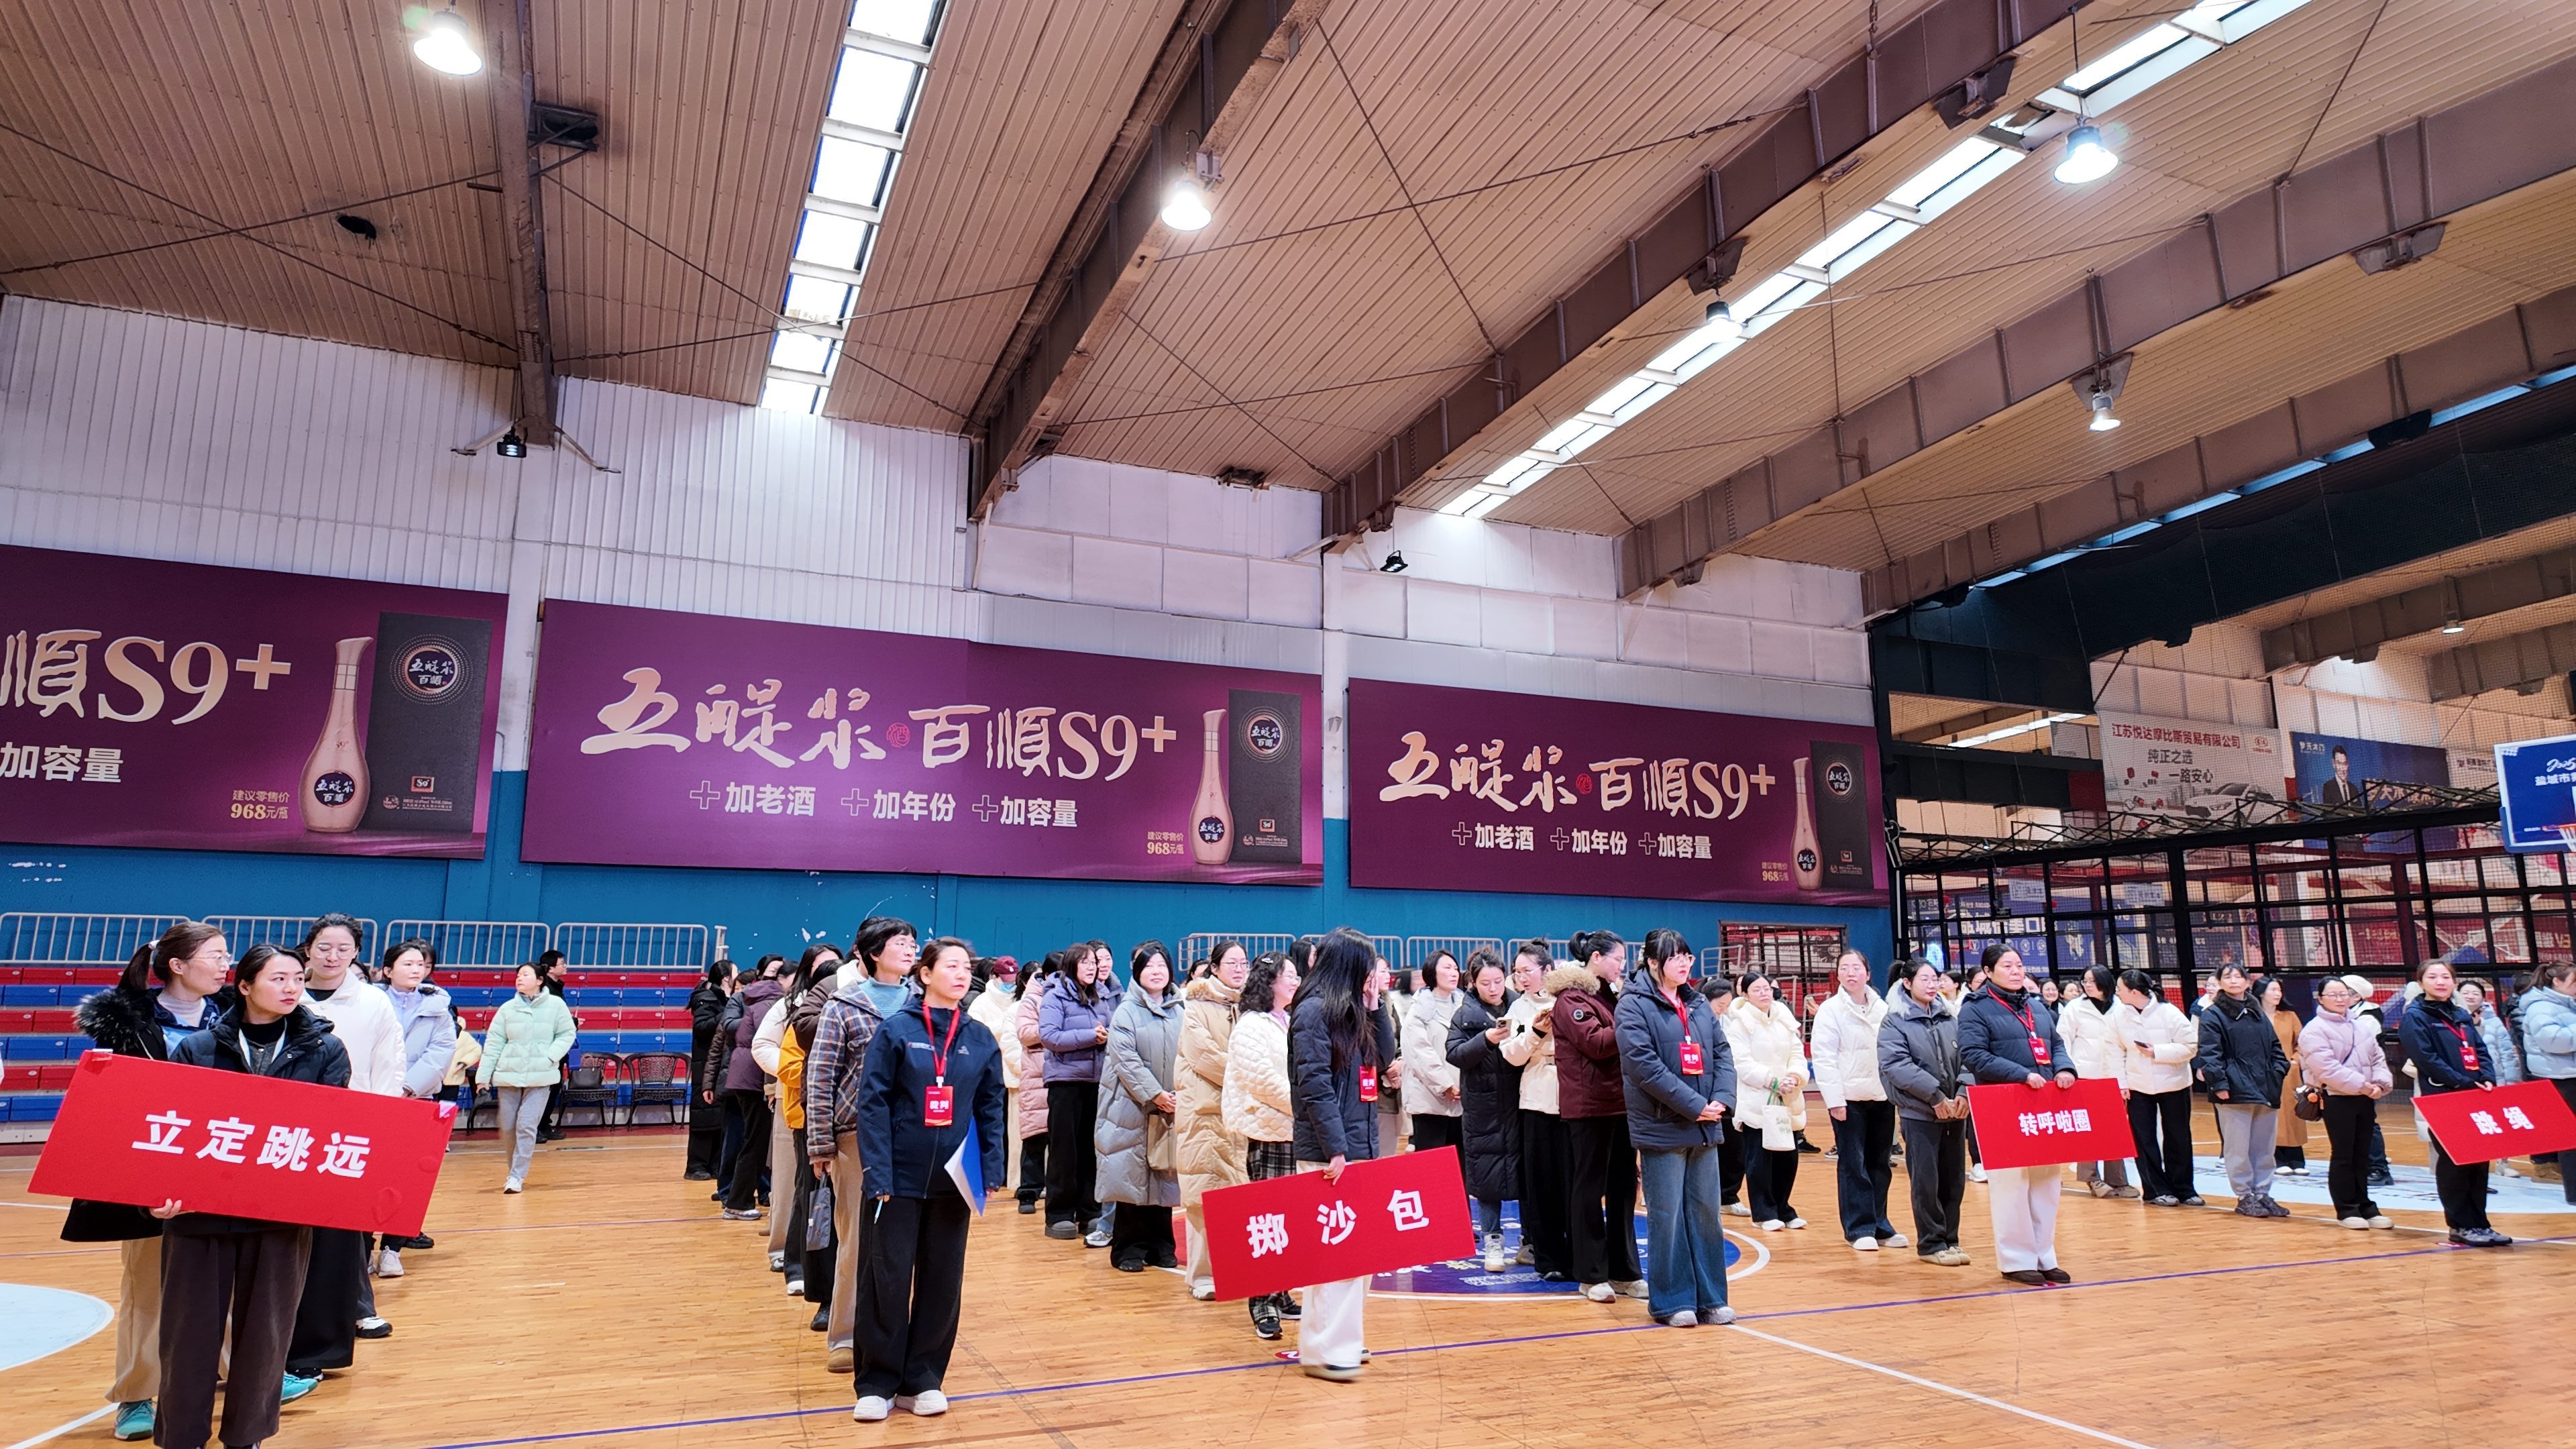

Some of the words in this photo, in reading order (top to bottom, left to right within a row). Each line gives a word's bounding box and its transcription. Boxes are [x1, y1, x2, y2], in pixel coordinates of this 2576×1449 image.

[0, 742, 123, 782] 加容量
[2147, 749, 2193, 765] 纯正之选
[2169, 768, 2213, 784] 一路安心
[233, 790, 290, 803] 建议零售价
[725, 782, 816, 816] 加老酒
[873, 790, 956, 821] 加年份
[1000, 796, 1078, 827] 加容量
[231, 803, 289, 820] 968元/瓶
[1148, 831, 1184, 842] 建议零售价
[1475, 823, 1534, 851] 加老酒
[1572, 828, 1628, 855] 加年份
[1658, 833, 1713, 859] 加容量
[2019, 1109, 2092, 1136] 转呼啦圈
[2470, 1106, 2534, 1135] 跳绳
[131, 1110, 371, 1179] 立定跳远
[1246, 1189, 1430, 1259] 掷沙包
